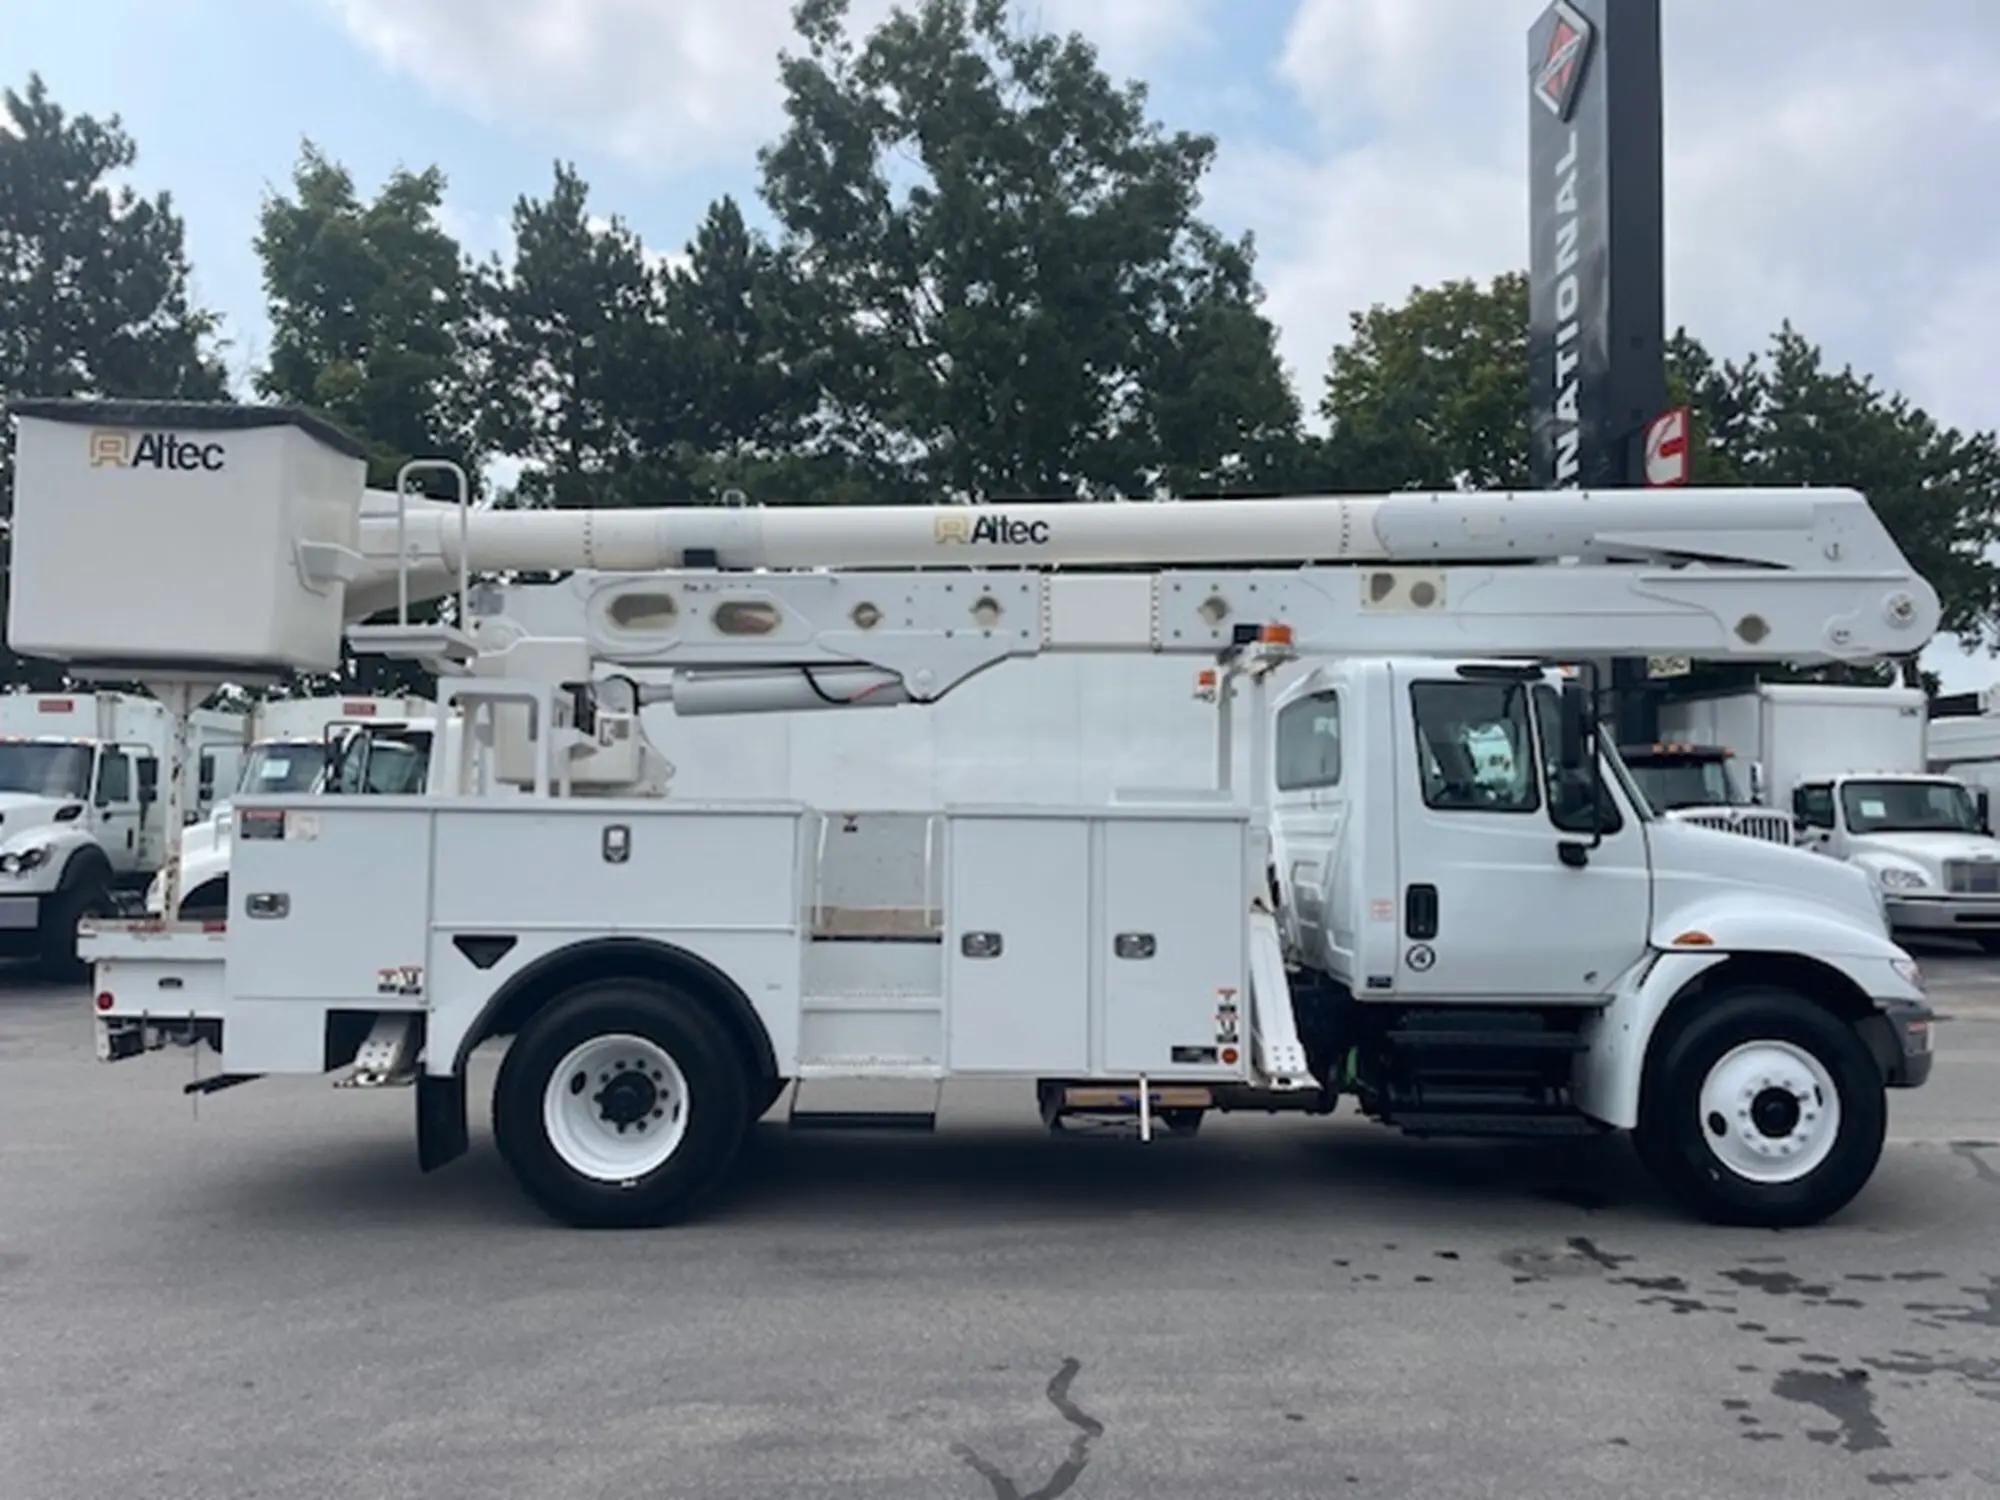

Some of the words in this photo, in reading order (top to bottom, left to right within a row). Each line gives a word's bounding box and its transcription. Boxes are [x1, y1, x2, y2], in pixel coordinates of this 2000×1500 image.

[1555, 130, 1579, 489] NATIONAL
[131, 432, 225, 471] Altec
[971, 514, 1050, 545] Altec
